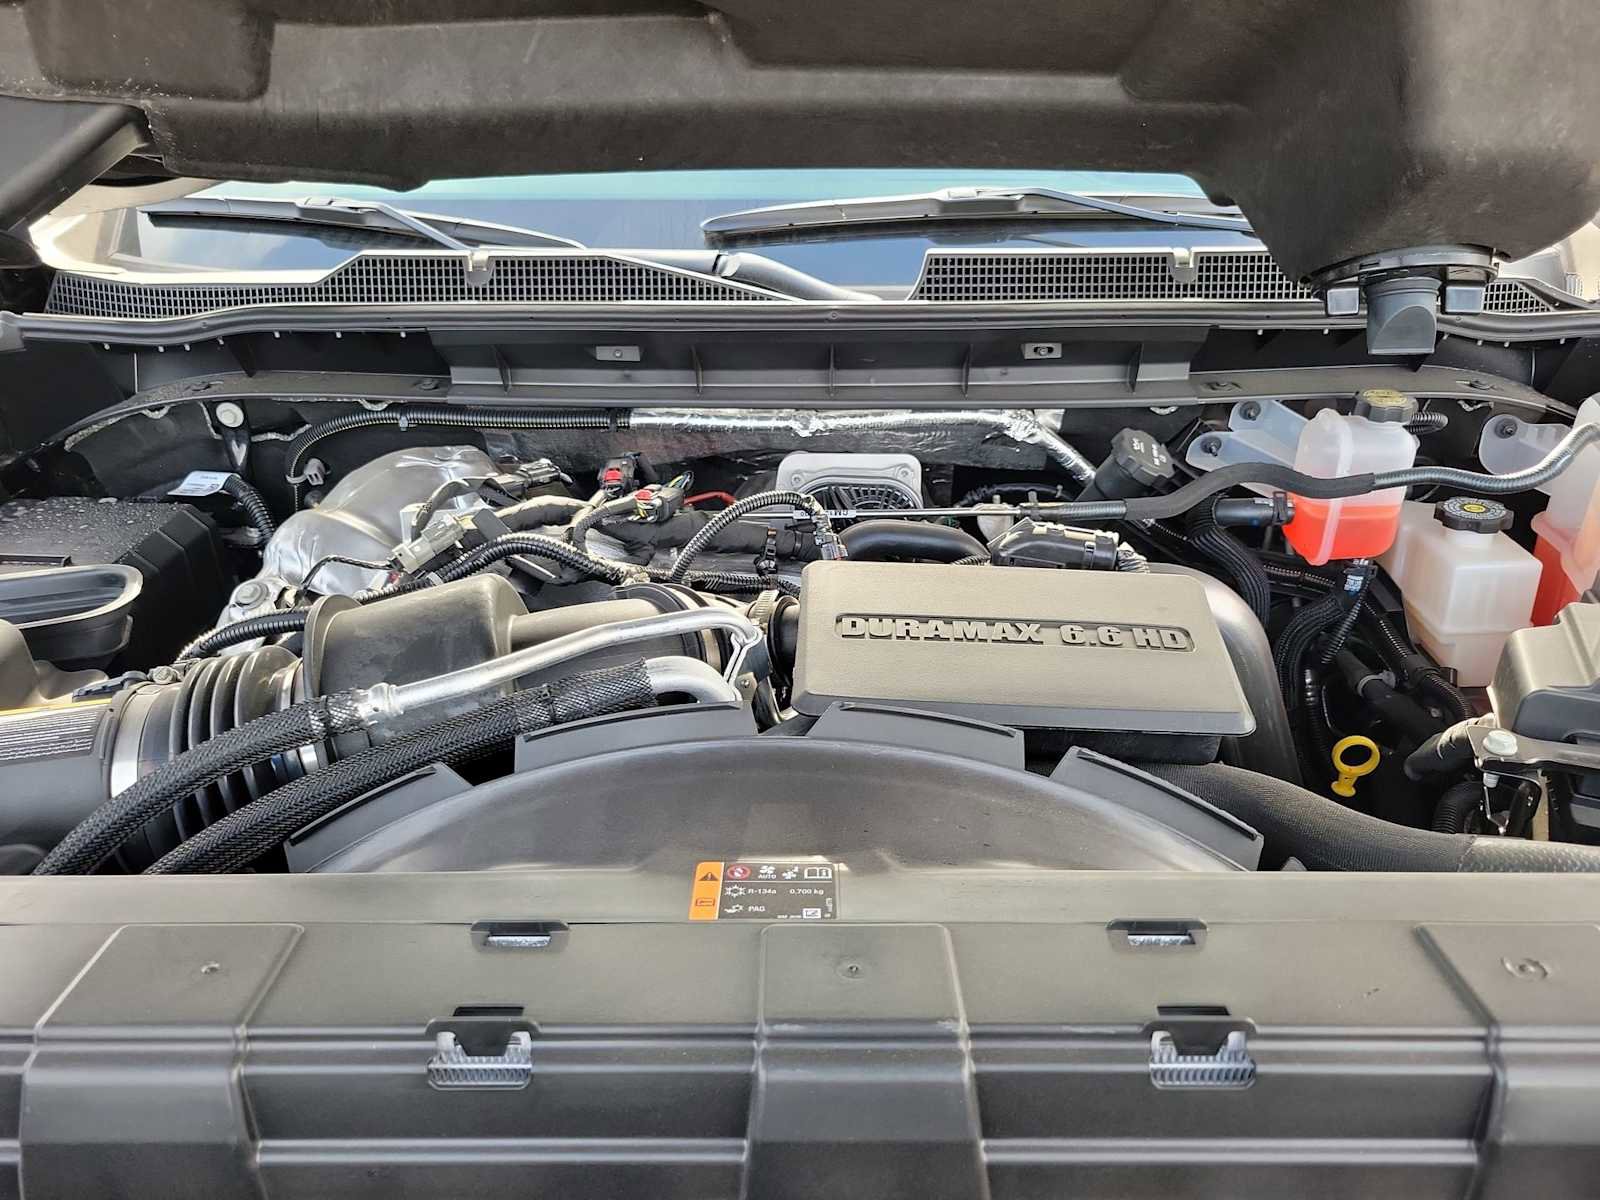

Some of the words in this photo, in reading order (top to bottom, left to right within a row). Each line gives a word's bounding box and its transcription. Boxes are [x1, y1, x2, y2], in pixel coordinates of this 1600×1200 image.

[841, 617, 1043, 643] DURAMAX
[1059, 624, 1123, 646] 6.6
[1131, 627, 1187, 649] HD
